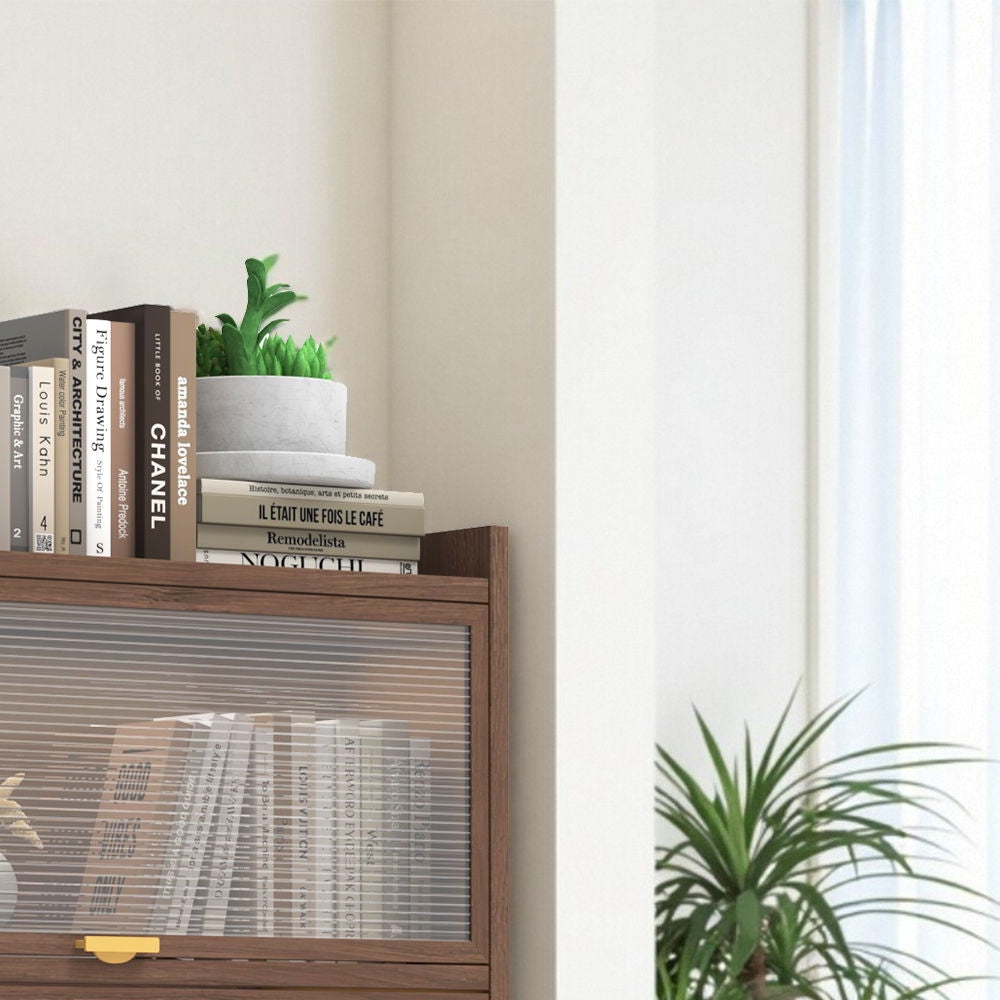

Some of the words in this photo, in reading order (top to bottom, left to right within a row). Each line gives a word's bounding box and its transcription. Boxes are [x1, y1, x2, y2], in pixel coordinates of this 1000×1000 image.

[72, 317, 82, 354] CITY
[72, 359, 81, 370] &
[92, 329, 108, 380] Figure
[39, 381, 50, 425] Louis
[154, 390, 161, 401] OF
[177, 376, 190, 437] amanda
[11, 394, 24, 436] Graphic
[57, 410, 66, 437] Painting
[92, 386, 108, 453] Drawing
[13, 439, 23, 448] &
[39, 436, 51, 477] Kahn
[72, 377, 82, 503] ARCHITECTURE
[13, 451, 23, 469] Art
[151, 423, 166, 529] CHANEL
[177, 442, 190, 506] lovelace
[118, 469, 128, 502] Antoine
[249, 484, 280, 494] Histoire,
[281, 486, 315, 497] botanique,
[318, 489, 332, 497] arts
[334, 490, 341, 498] et
[343, 491, 362, 499] petits
[364, 493, 389, 501] secrets
[40, 515, 47, 531] 4
[94, 496, 103, 529] Painting
[118, 504, 128, 539] Predock
[259, 504, 268, 520] IL
[270, 503, 298, 522] ÉTAIT
[300, 506, 319, 523] UNE
[322, 508, 343, 525] FOIS
[346, 510, 357, 525] LE
[360, 509, 384, 527] CAFÉ
[14, 528, 21, 538] 2
[267, 531, 346, 549] Remodelista
[299, 766, 308, 803] LOUIS
[344, 737, 355, 818] AFTERWORD
[414, 759, 430, 808] Renzo
[298, 808, 308, 860] VUITTON
[366, 830, 378, 865] West
